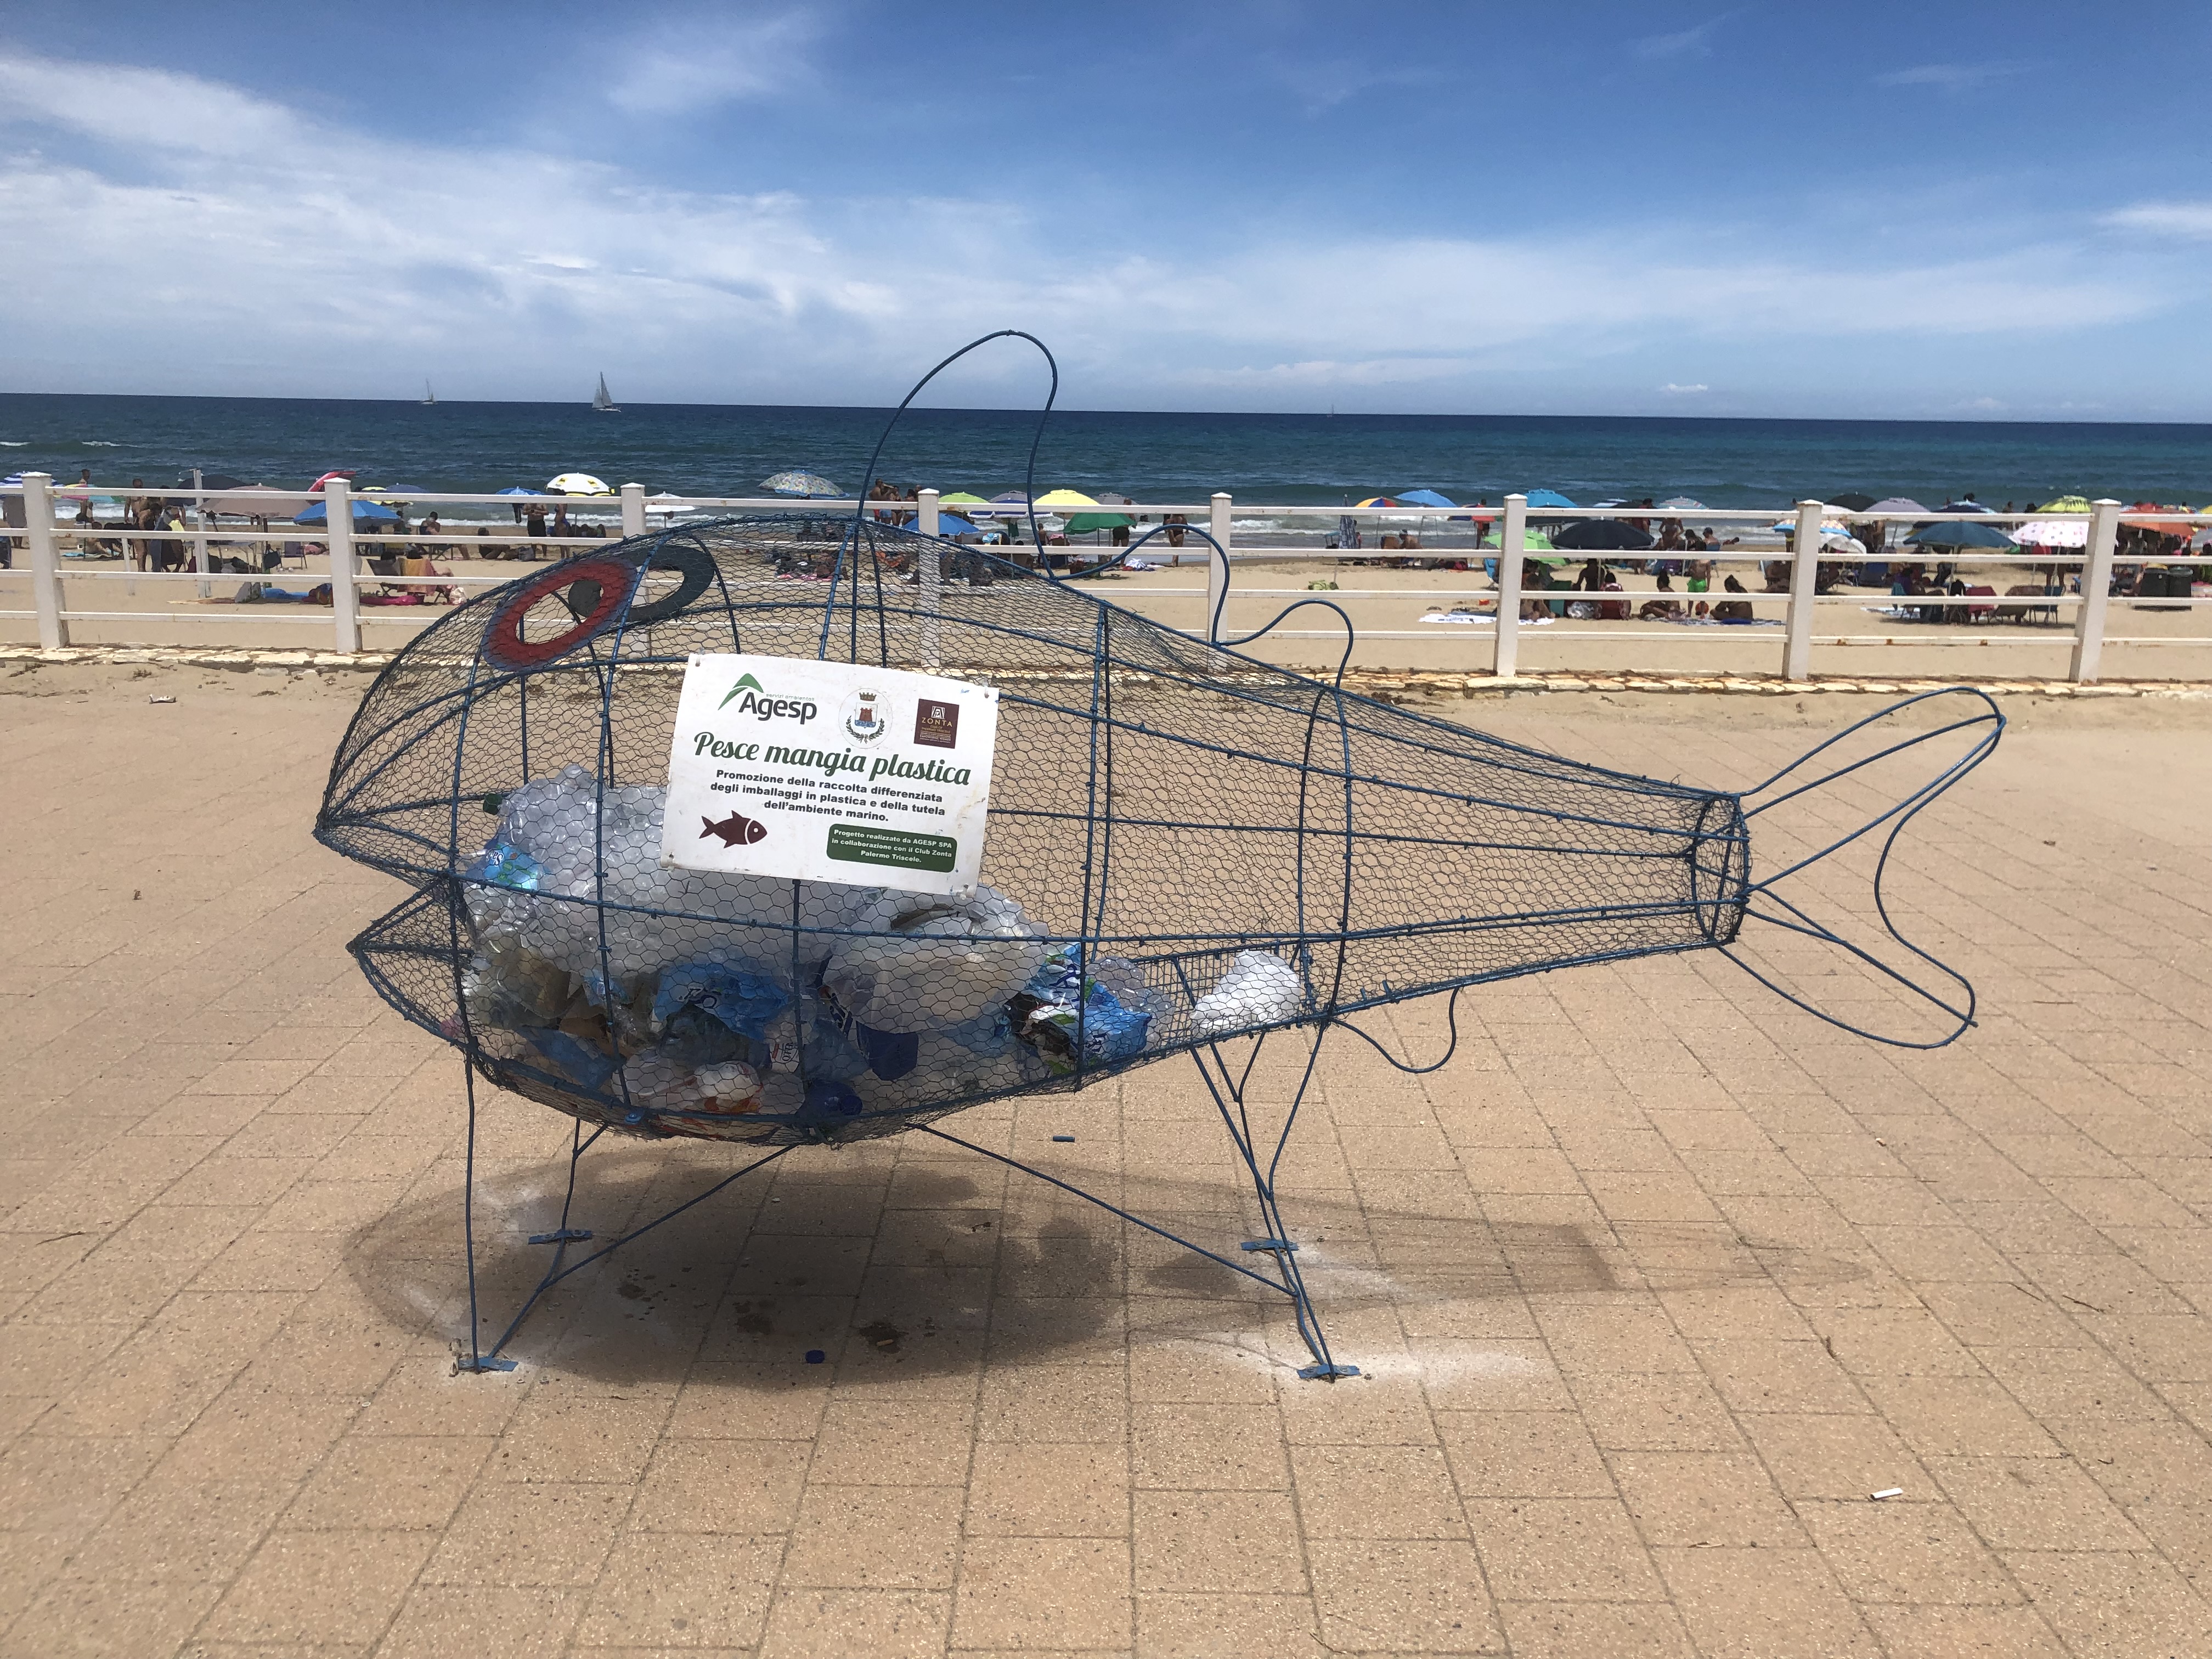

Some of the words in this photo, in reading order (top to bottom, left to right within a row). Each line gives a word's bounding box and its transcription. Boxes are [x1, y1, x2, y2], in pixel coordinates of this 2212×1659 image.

[738, 692, 817, 725] Agesp
[922, 717, 952, 727] ZONTA
[694, 731, 760, 761] Pesce
[764, 746, 867, 777] mangia
[868, 754, 971, 786] plastica
[716, 770, 784, 783] Promozione
[787, 776, 815, 787] della
[819, 781, 867, 793] raccolta
[871, 786, 943, 803] differenziata
[710, 782, 739, 794] degli
[742, 785, 803, 800] imballaggi
[806, 791, 816, 800] in
[820, 793, 866, 806] plastica
[881, 800, 909, 811] della
[912, 804, 945, 816] tutela
[764, 800, 842, 816] dell’ambiente
[846, 810, 889, 822] marino.
[834, 829, 865, 838] Progetto
[866, 834, 900, 843] realizzato
[912, 838, 937, 847] AGESP
[840, 839, 892, 850] collaborazione
[932, 849, 952, 857] Zonta
[860, 850, 890, 859] Palermo
[891, 854, 922, 863] Triscele.
